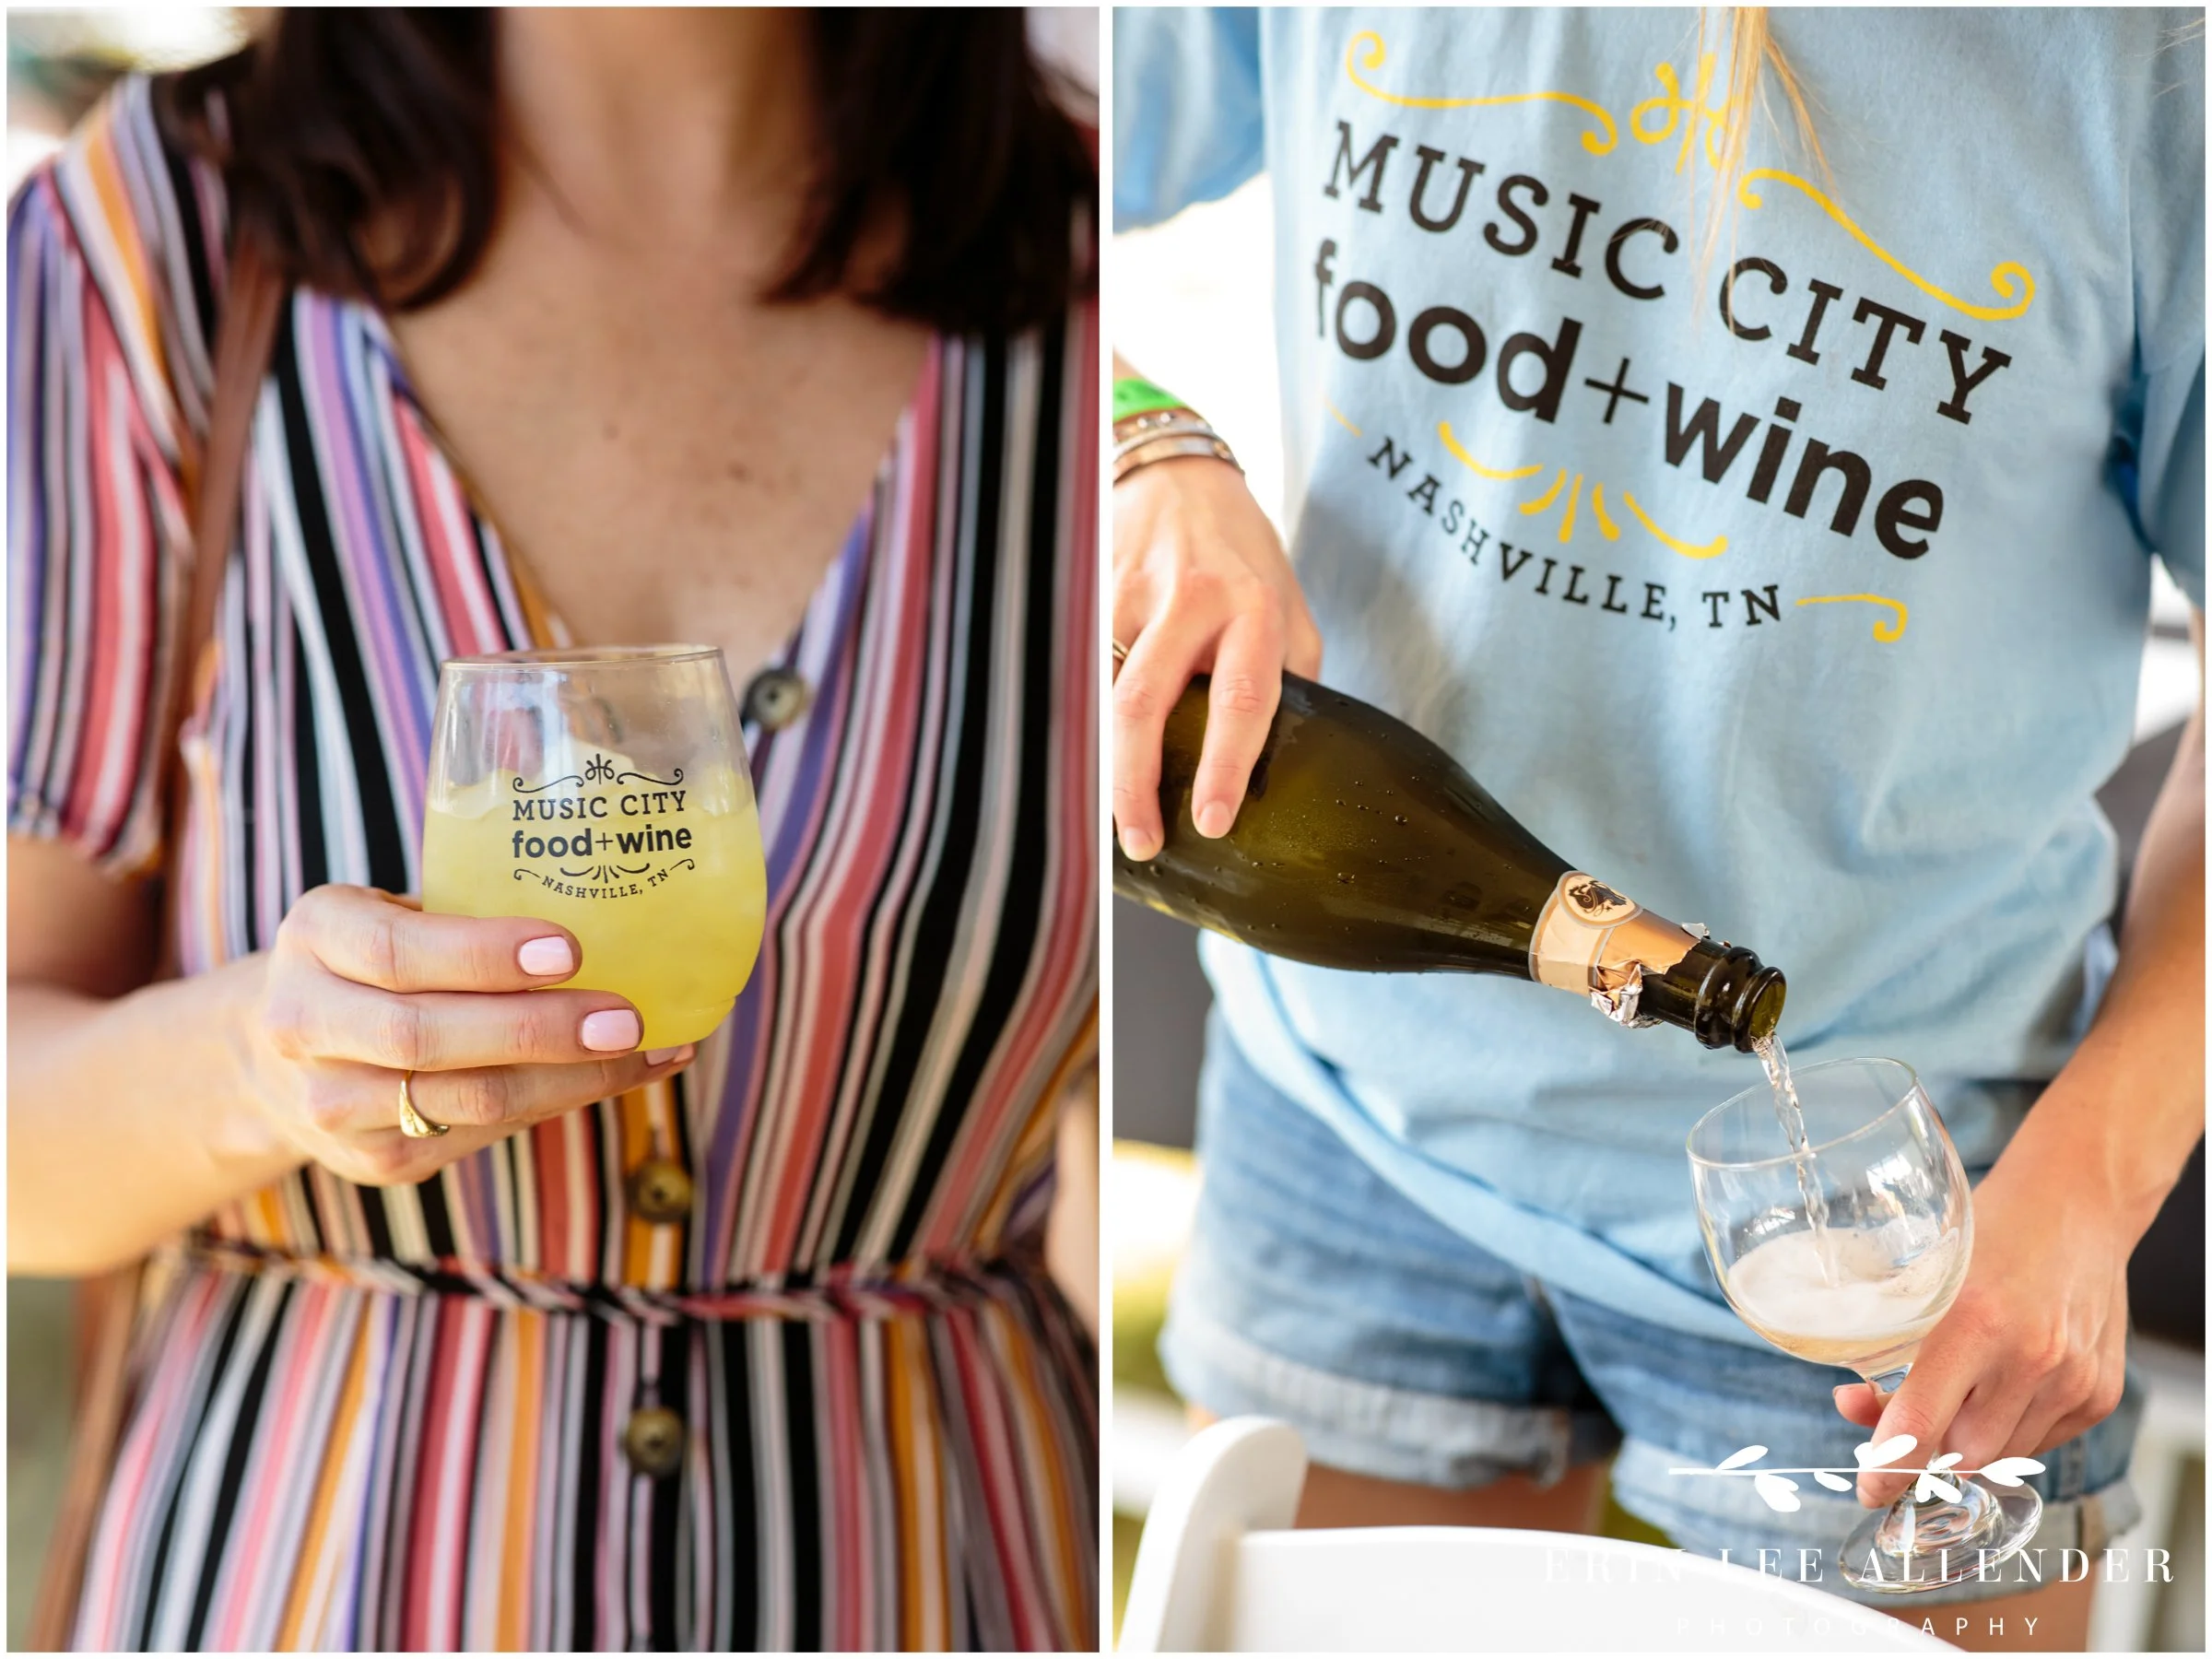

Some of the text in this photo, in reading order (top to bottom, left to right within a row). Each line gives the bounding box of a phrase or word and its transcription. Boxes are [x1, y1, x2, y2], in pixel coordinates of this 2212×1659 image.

[1323, 120, 2012, 425] MUSIC CITY
[1313, 238, 1945, 560] food+wine
[1368, 436, 1783, 631] NASHVILLE, TN
[512, 790, 687, 820] MUSIC CITY
[512, 824, 692, 858] food+wine
[542, 868, 669, 900] NASHVILLE, TN
